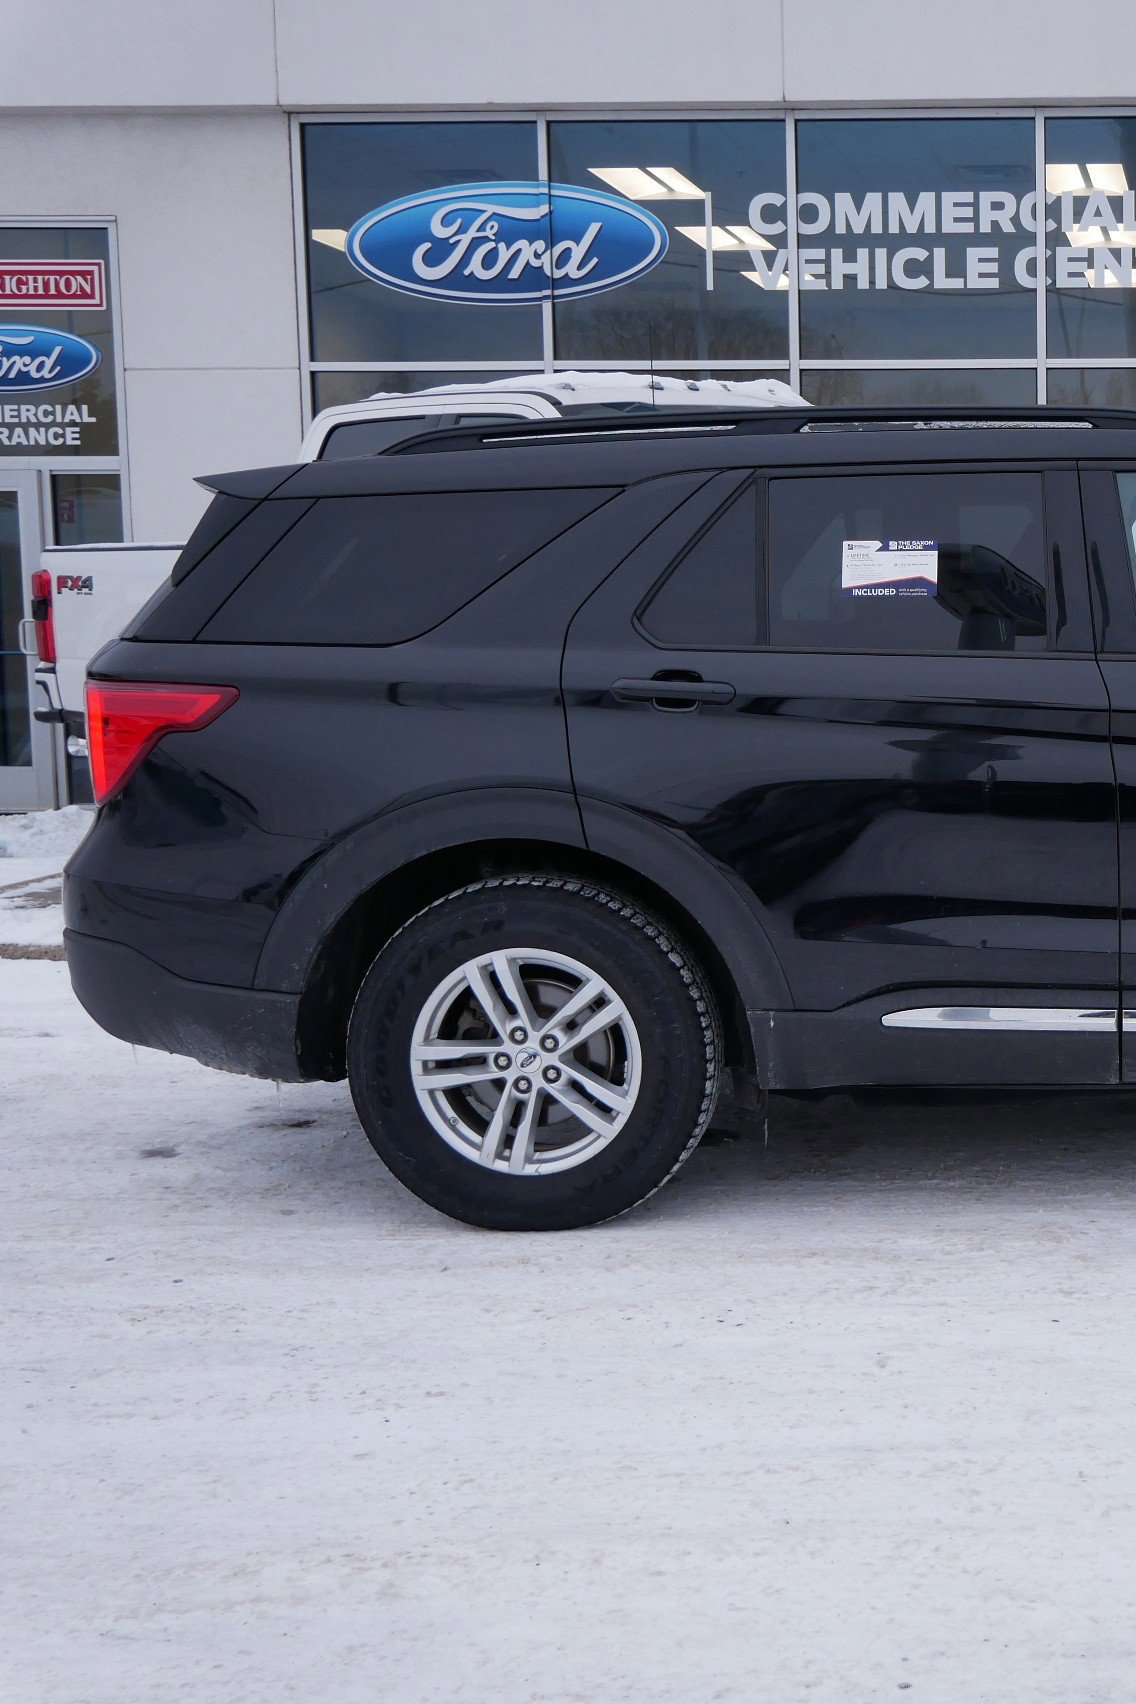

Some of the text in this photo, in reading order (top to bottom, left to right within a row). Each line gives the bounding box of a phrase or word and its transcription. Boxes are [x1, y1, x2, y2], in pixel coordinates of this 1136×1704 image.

[412, 202, 602, 280] Ford
[749, 247, 999, 291] VEHICLE
[0, 275, 92, 295] IGHTON
[0, 404, 97, 423] ERCIAL
[57, 575, 93, 595] FX4
[852, 588, 896, 596] INCLUDED
